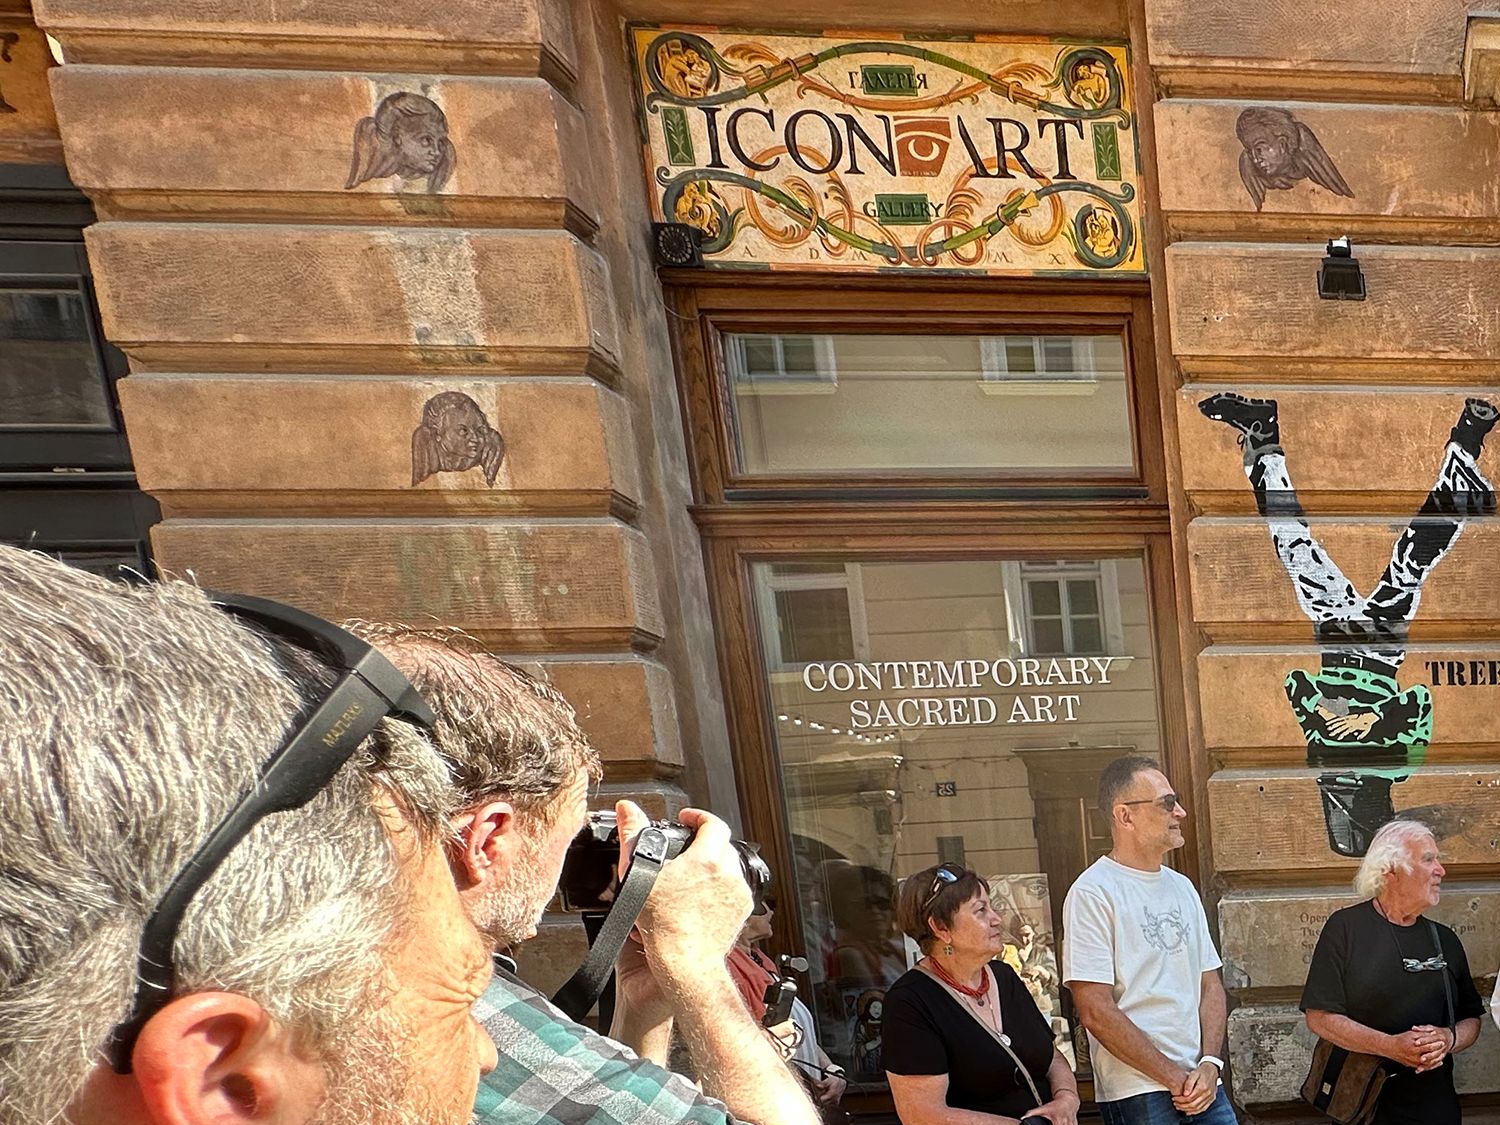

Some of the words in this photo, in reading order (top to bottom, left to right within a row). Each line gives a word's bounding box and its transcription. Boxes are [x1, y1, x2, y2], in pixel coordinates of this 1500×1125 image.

[699, 107, 899, 178] ICON
[956, 114, 1084, 181] ART
[862, 201, 945, 219] GALLERY
[802, 656, 1115, 692] CONTEMPORARY
[850, 697, 997, 729] SACRED
[1007, 695, 1081, 724] ART
